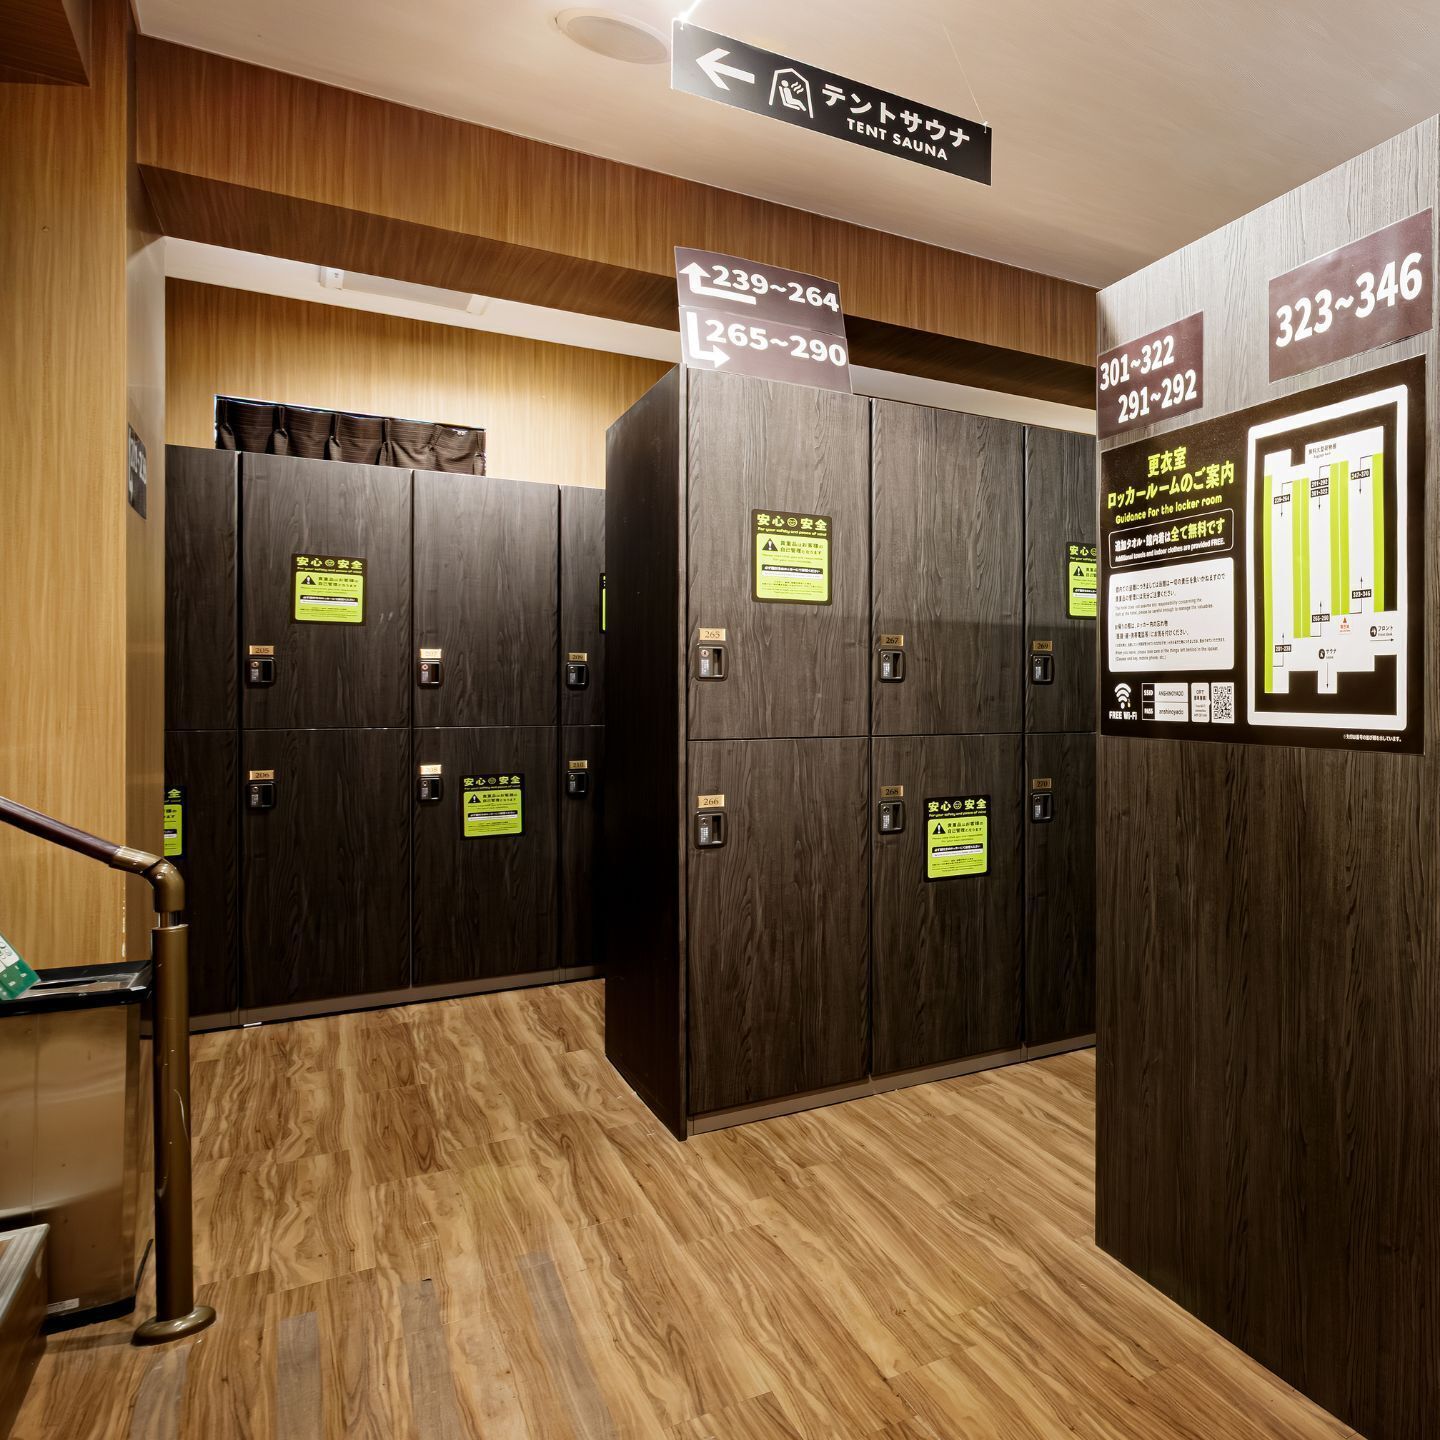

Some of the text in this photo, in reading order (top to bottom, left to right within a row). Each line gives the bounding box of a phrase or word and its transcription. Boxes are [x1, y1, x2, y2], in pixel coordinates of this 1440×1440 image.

[821, 83, 970, 148] テントサウナ
[847, 118, 948, 161] TENT SAUNA
[712, 265, 840, 312] 239~264
[1275, 252, 1423, 348] 323~346
[705, 319, 847, 367] 265~290
[1099, 335, 1175, 391] 301~322
[1117, 369, 1197, 424] 291~292
[1147, 446, 1187, 478] 更衣室
[1107, 460, 1235, 509] ロッカールームのご案内
[757, 514, 827, 531] 安心 安全
[1115, 511, 1146, 524] Guidance
[1161, 504, 1174, 514] the
[1176, 500, 1200, 512] locker
[1201, 495, 1222, 507] room
[296, 556, 362, 569] 安心 安全
[1070, 545, 1089, 556] 安心
[1109, 711, 1122, 720] FREE
[168, 789, 181, 798] 全
[928, 799, 986, 812] 安心 安全
